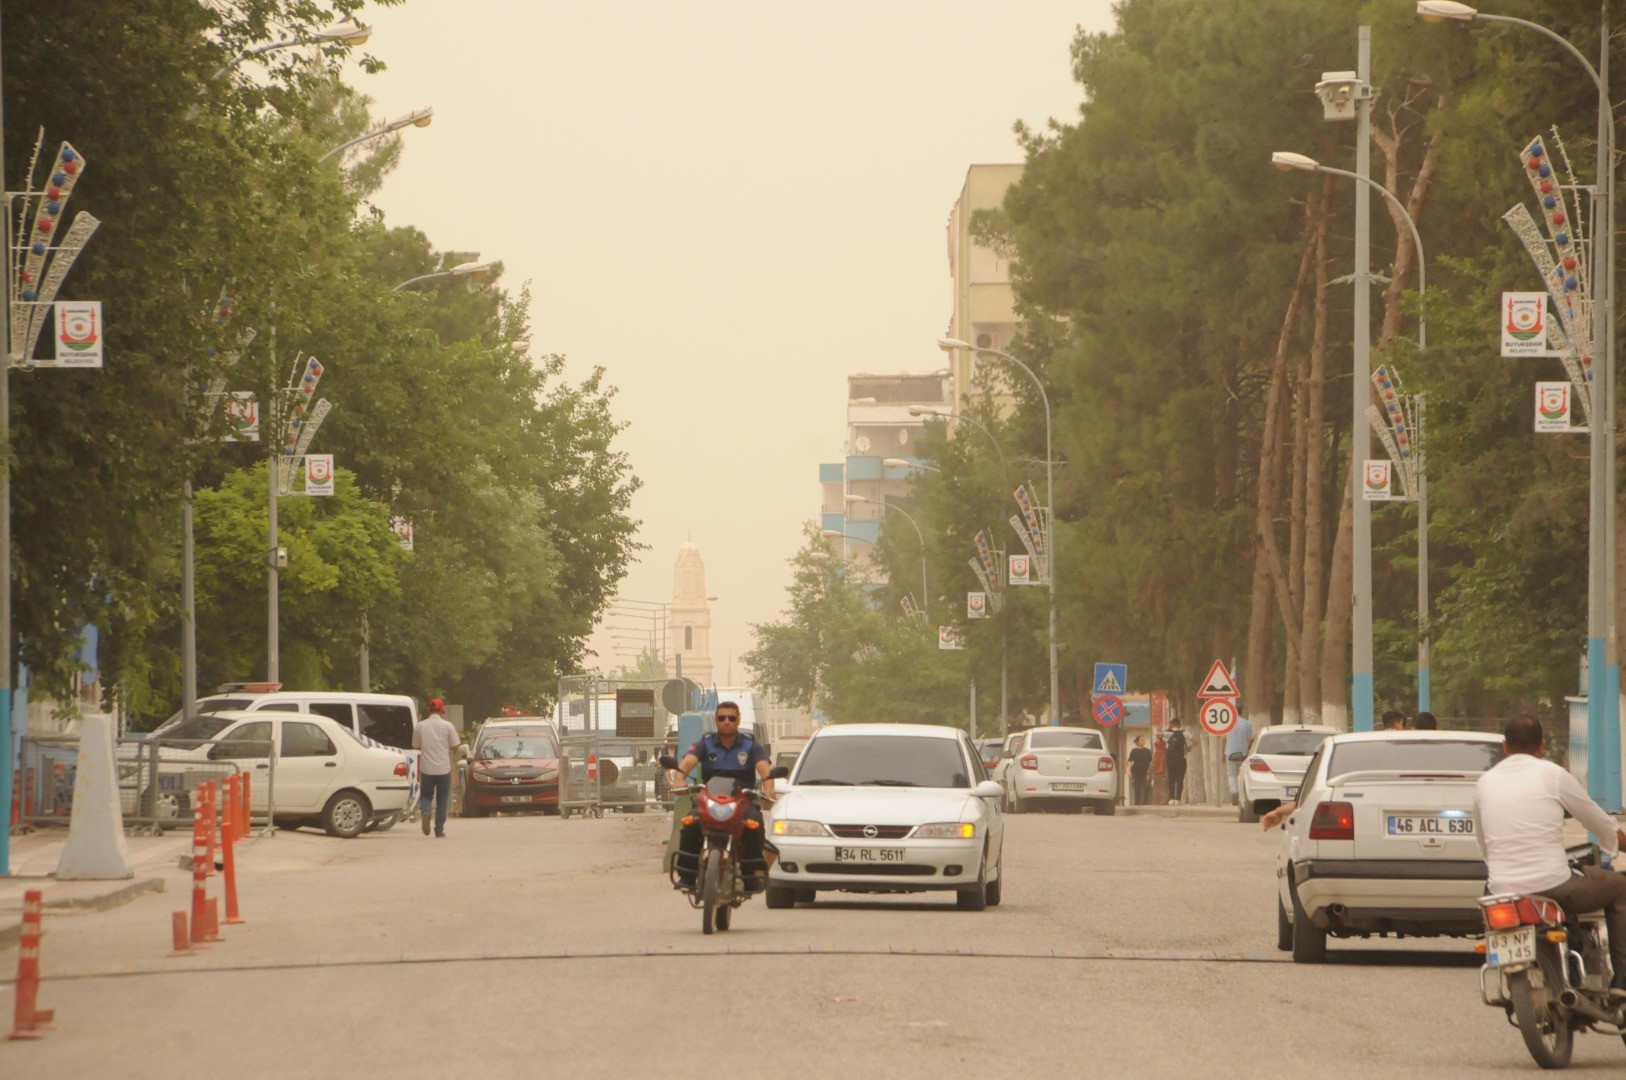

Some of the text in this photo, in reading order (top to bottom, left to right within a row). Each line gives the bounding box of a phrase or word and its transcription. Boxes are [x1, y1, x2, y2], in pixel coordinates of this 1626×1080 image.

[1209, 708, 1230, 724] 30
[1397, 818, 1474, 833] 46 ACL 630
[842, 849, 903, 861] 34 RL 5611
[1508, 945, 1531, 961] 145
